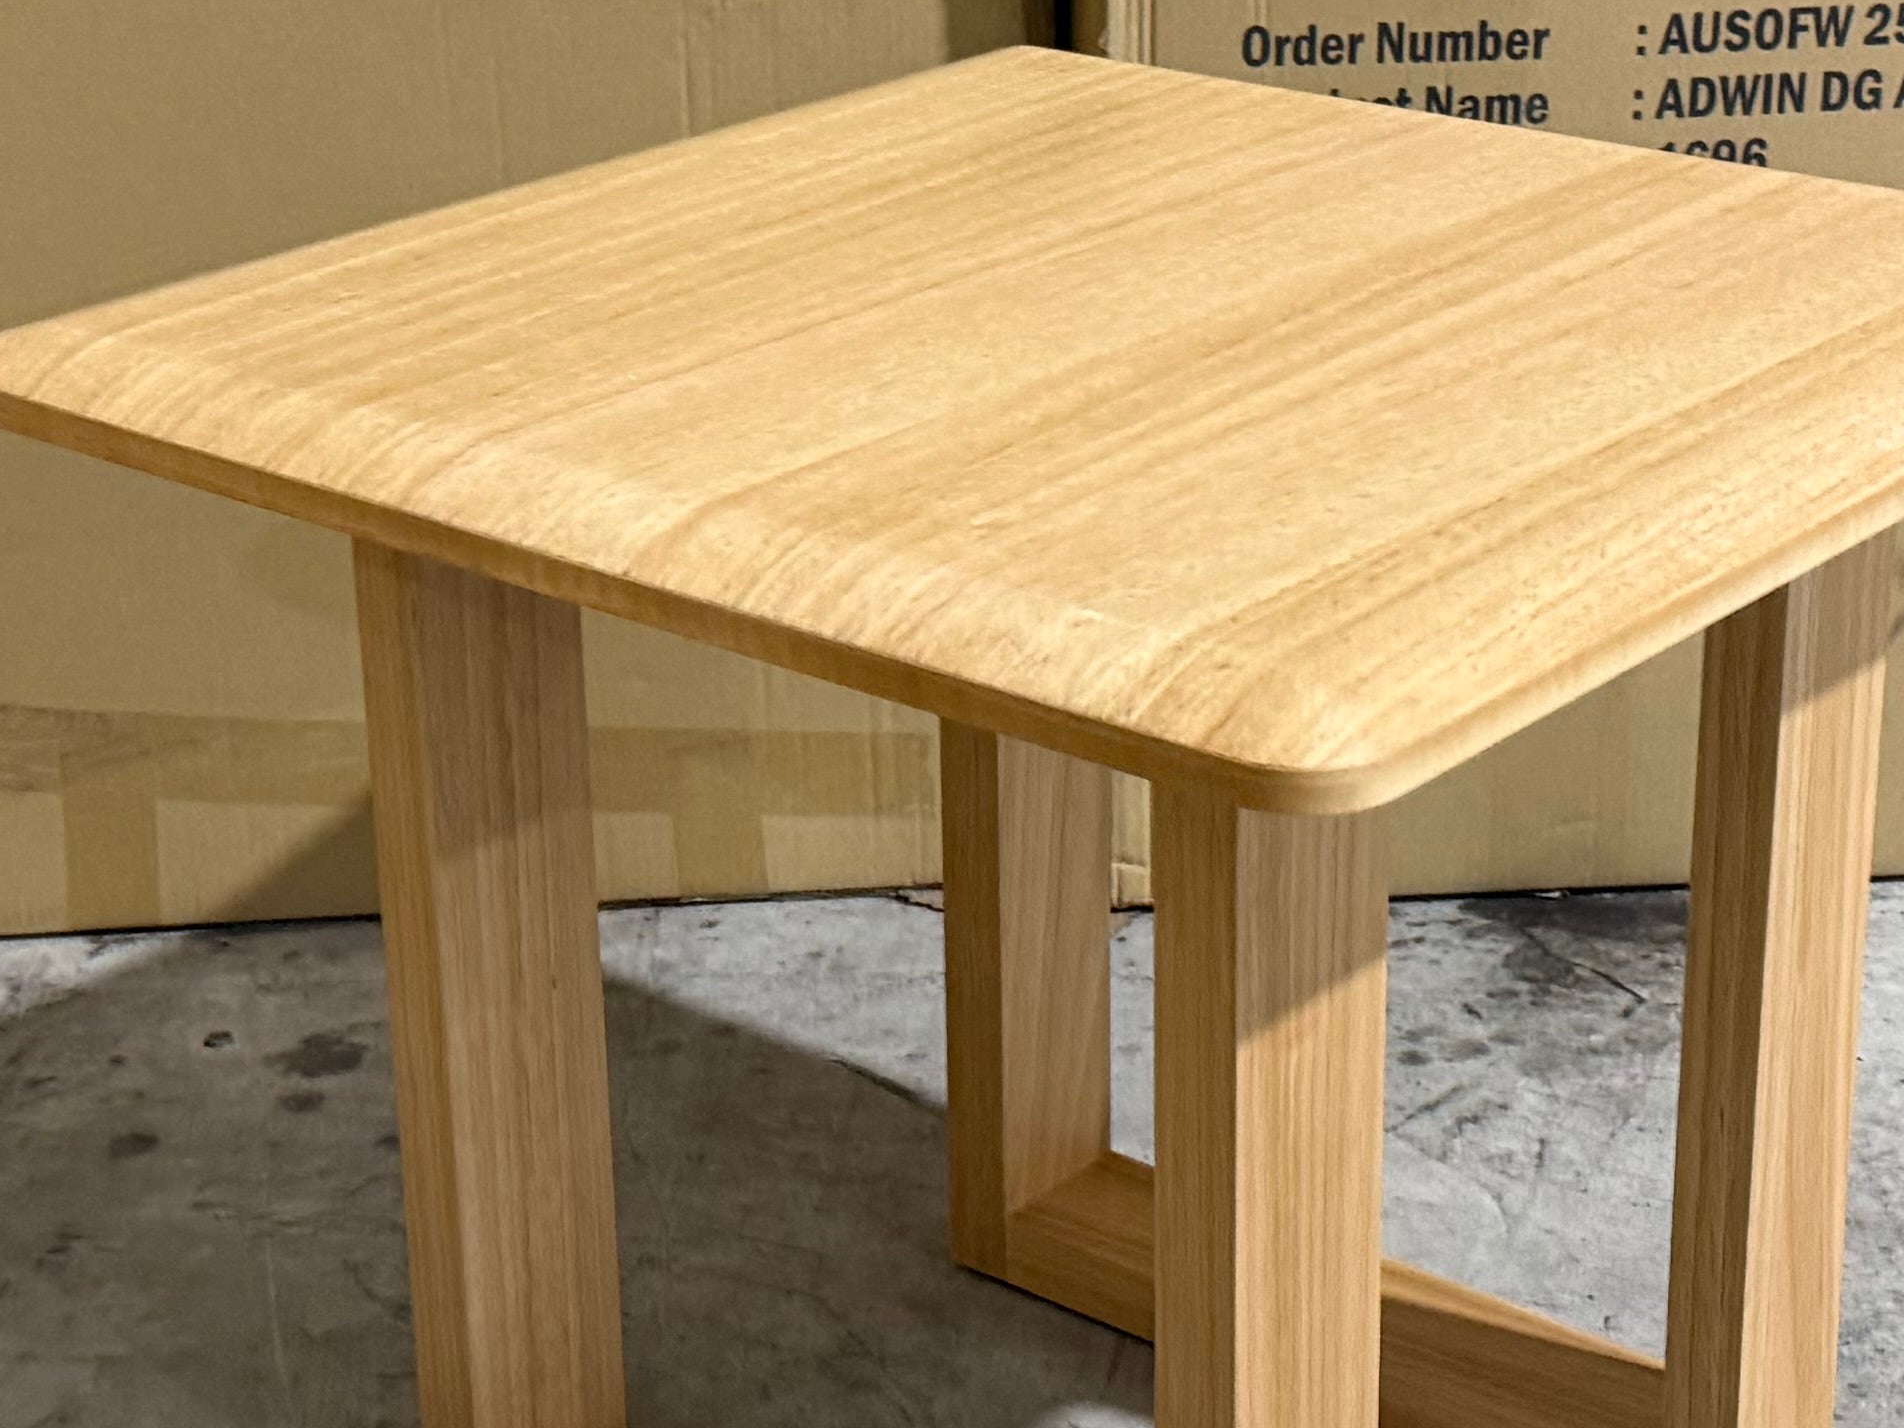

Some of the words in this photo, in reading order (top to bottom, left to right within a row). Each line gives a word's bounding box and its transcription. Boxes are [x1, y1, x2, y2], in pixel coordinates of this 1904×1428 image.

[1241, 24, 1364, 68] Order
[1377, 20, 1550, 64] Number
[1658, 4, 1855, 55] AUSOFW
[1424, 85, 1549, 125] Name
[1654, 72, 1807, 120] ADWIN
[1820, 69, 1883, 112] DG
[1658, 138, 1768, 169] 96
